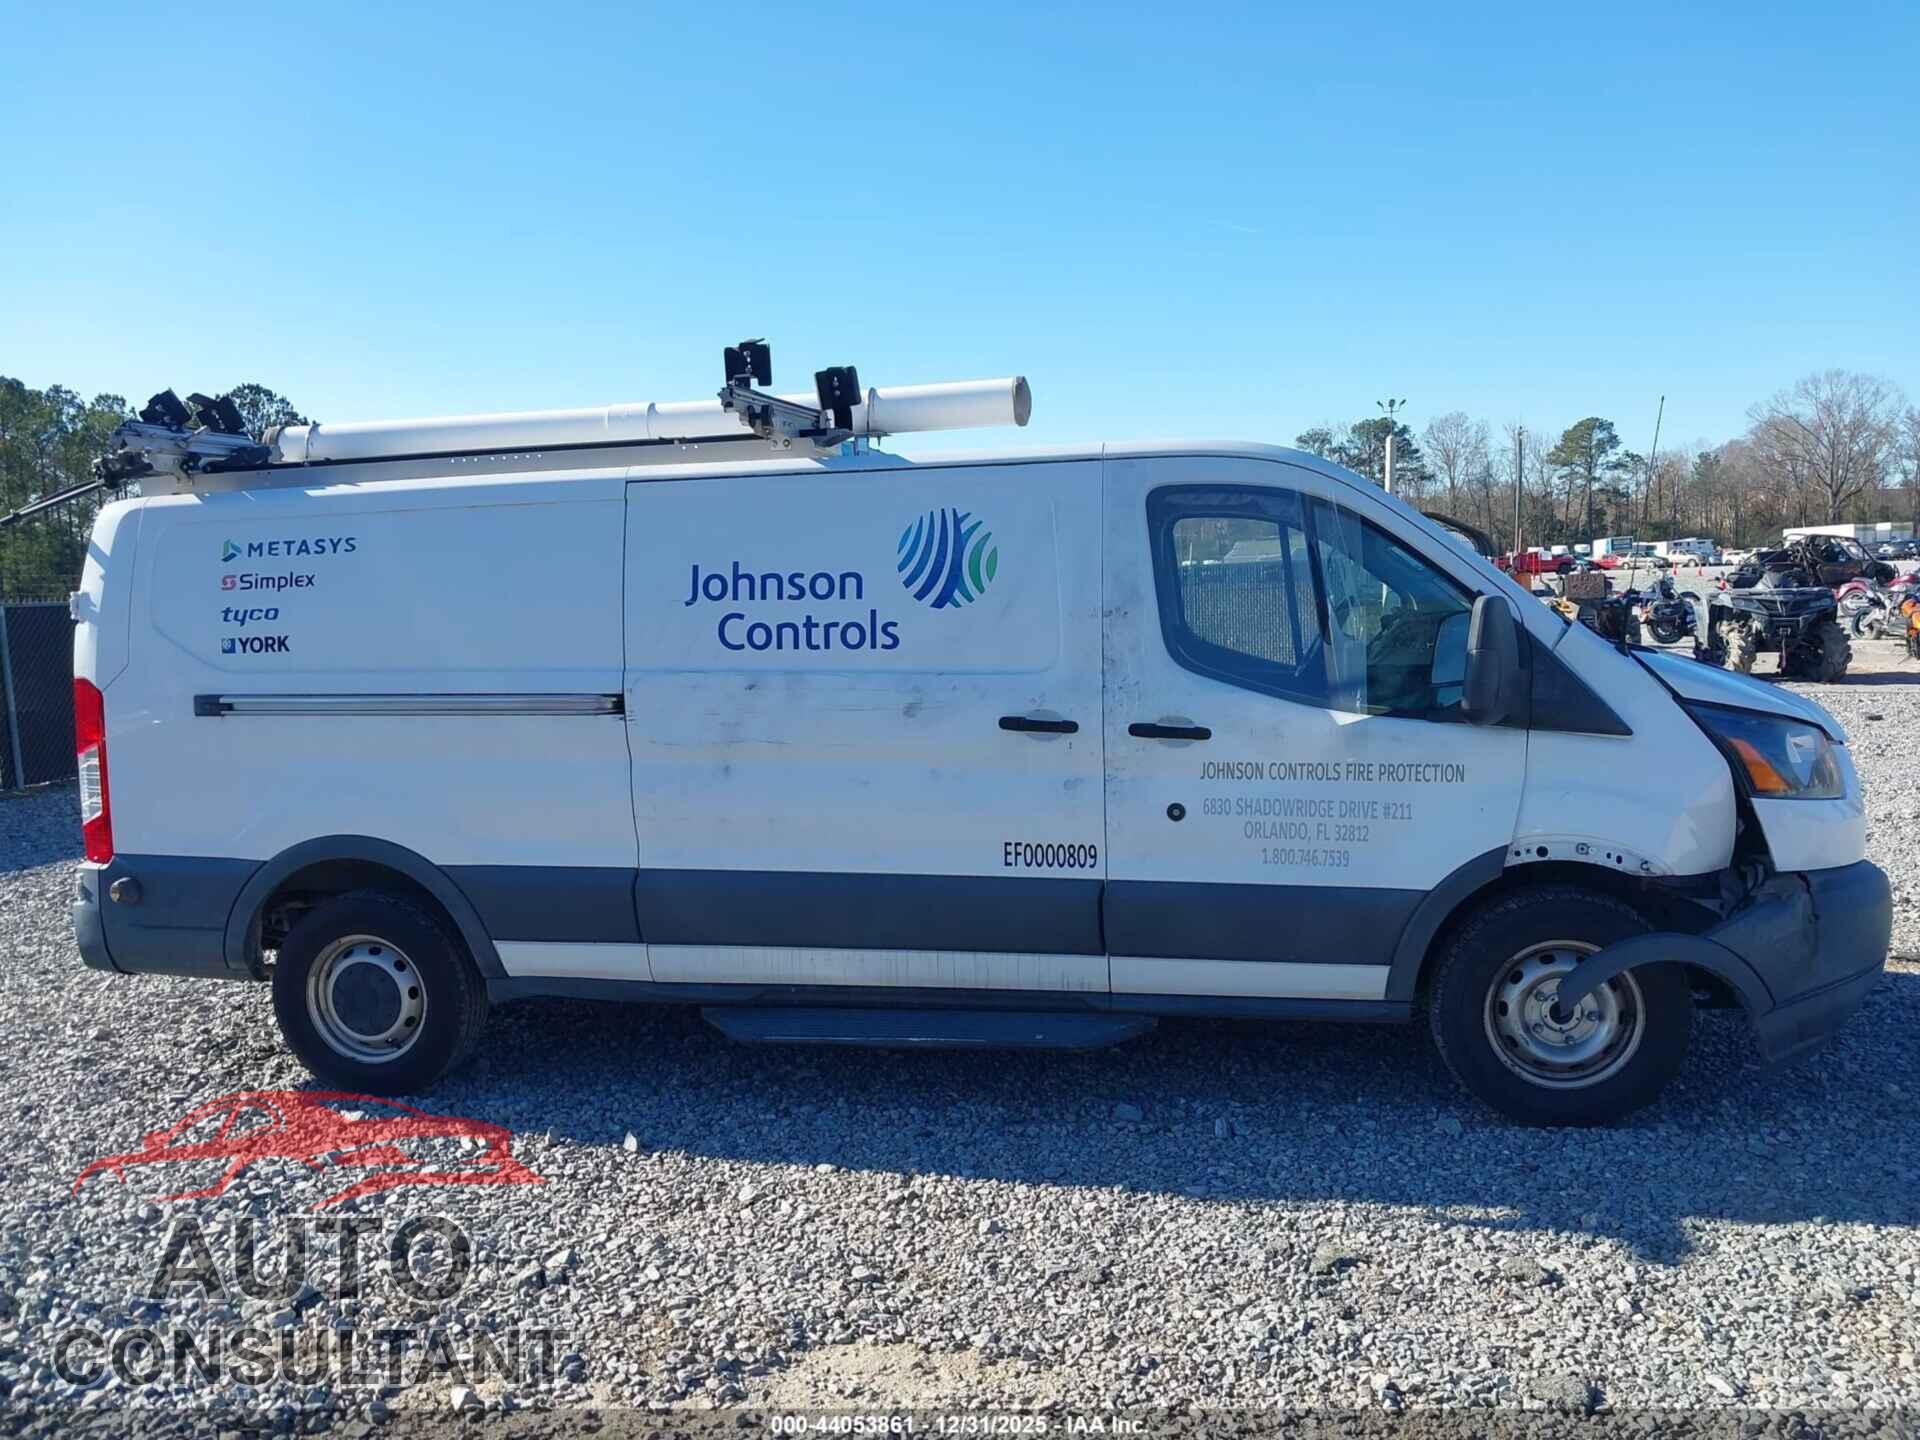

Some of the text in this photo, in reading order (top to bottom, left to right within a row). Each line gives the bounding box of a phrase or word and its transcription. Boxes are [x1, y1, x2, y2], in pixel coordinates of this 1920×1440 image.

[247, 537, 357, 558] METASYS
[239, 571, 316, 592] Simplex
[684, 561, 863, 607] Johnson
[221, 606, 280, 627] tyco
[718, 609, 900, 651] Controls
[238, 635, 291, 654] YORK
[1200, 761, 1465, 783] JOHNSON CONTROLS FIRE PROTECTION
[1202, 798, 1413, 820] 6830 SHADOWRIDGE DRIVE #211
[1243, 820, 1369, 844] ORLANDO, FL 32812
[1003, 842, 1098, 869] EF0000809
